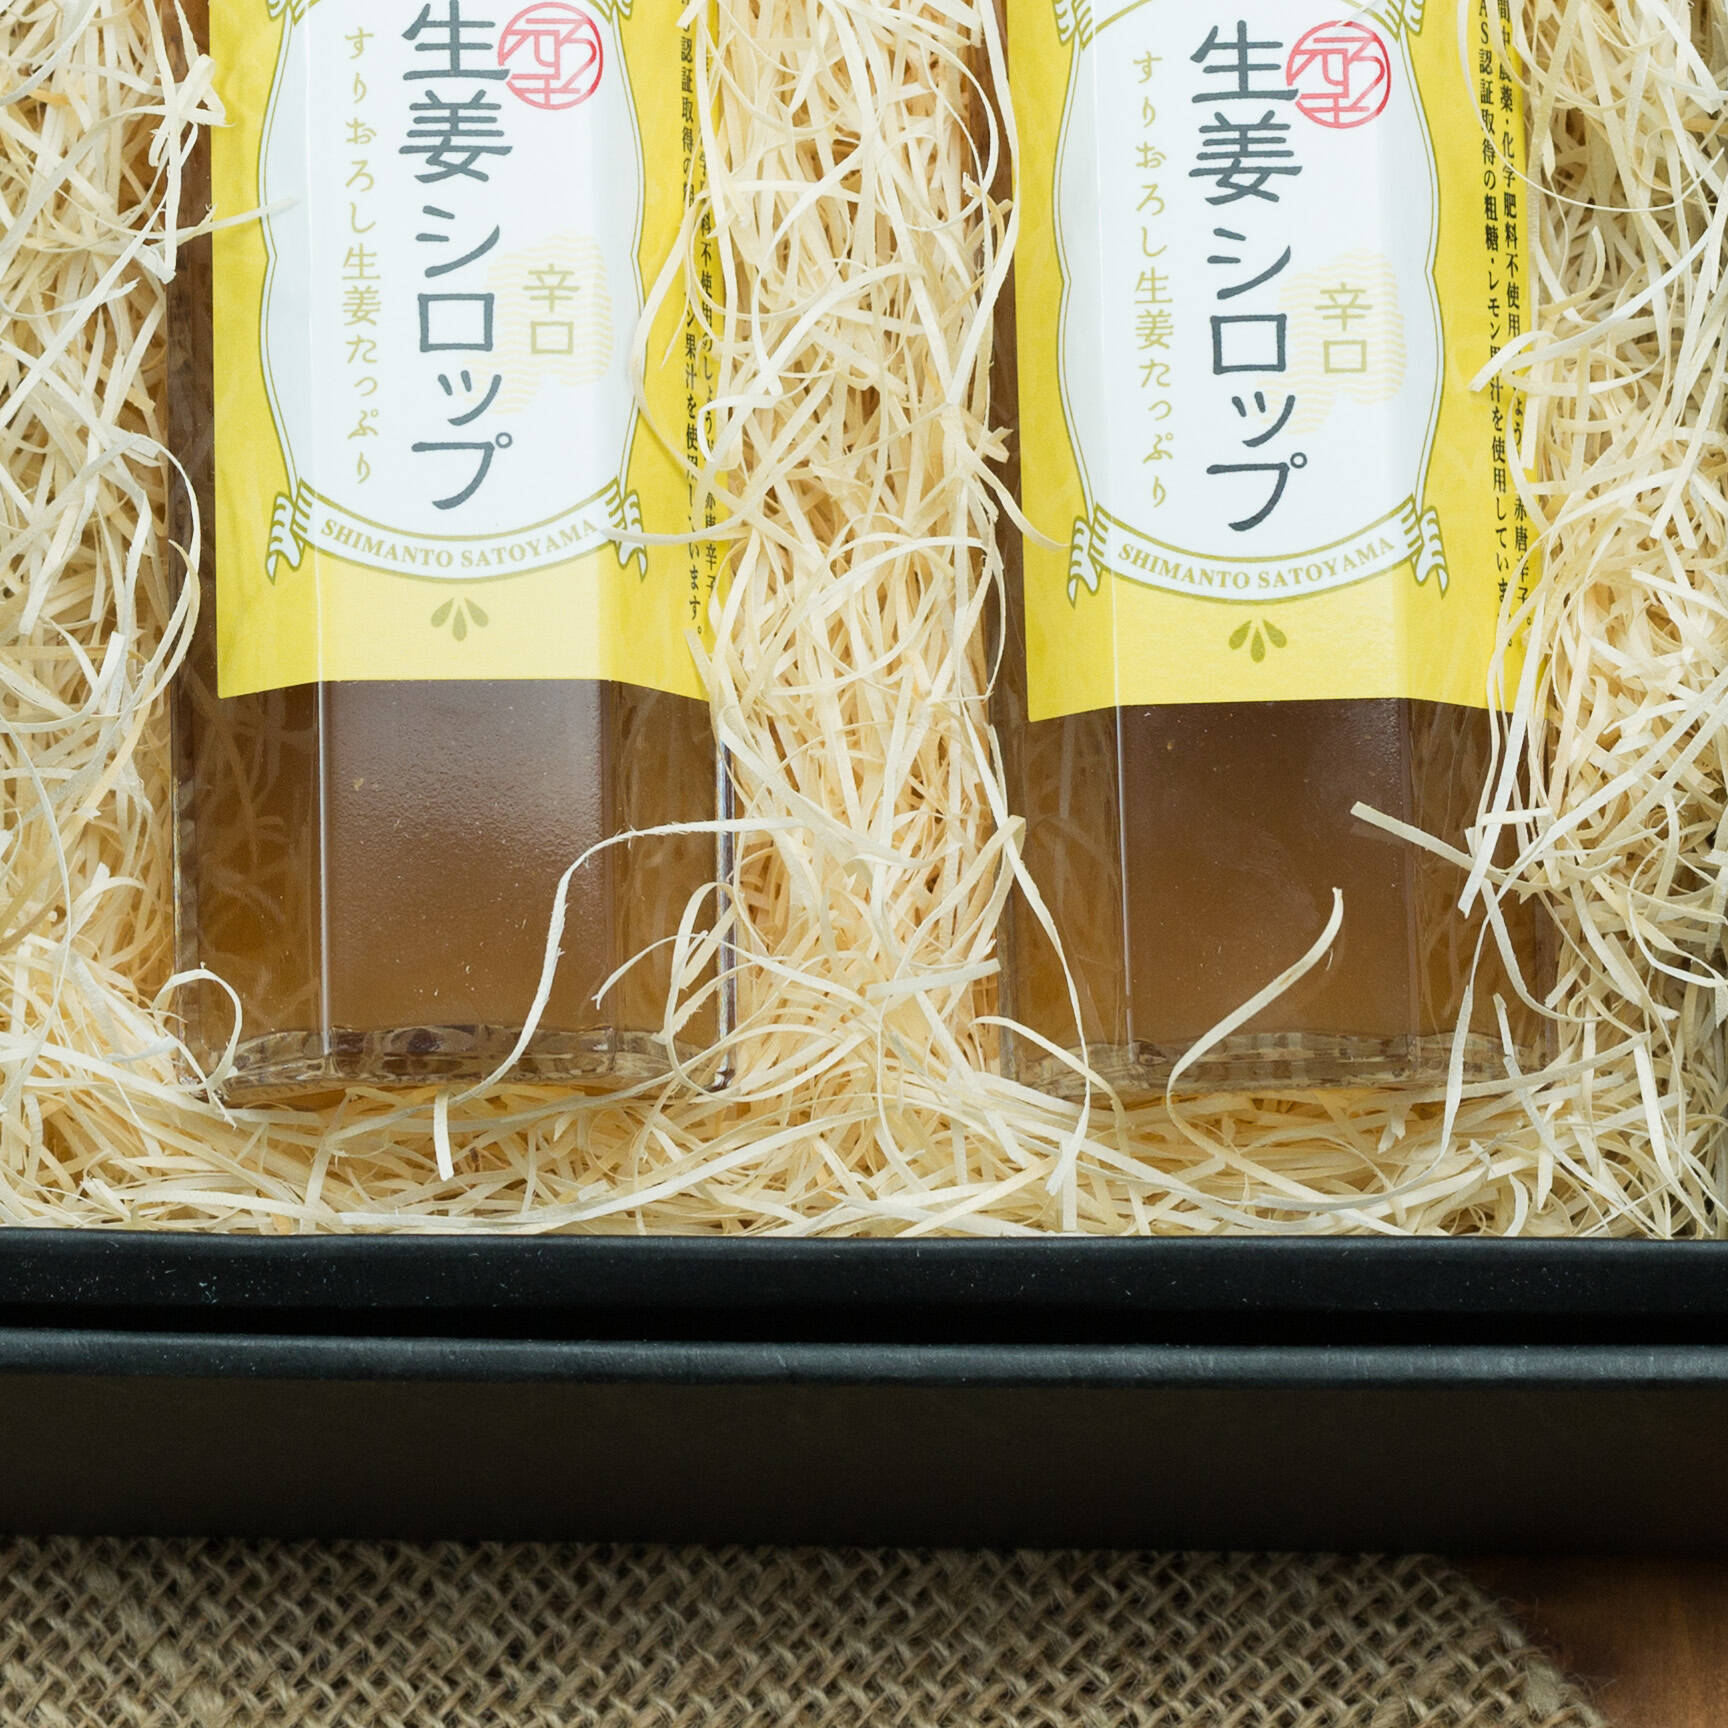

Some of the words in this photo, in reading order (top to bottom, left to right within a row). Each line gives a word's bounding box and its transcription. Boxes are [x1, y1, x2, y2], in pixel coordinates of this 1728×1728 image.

[342, 26, 382, 486] すりおろし生姜たっぷり
[1133, 49, 1175, 509] すりおろし生姜たっぷり
[1188, 20, 1308, 532] 生姜シロップ
[524, 264, 581, 357] 辛口
[1314, 282, 1373, 374] 辛口
[321, 519, 452, 568] SHIMANTO
[462, 519, 599, 567] SATOYAMA
[1119, 544, 1250, 590] SHIMANTO
[1258, 538, 1395, 589] SATOYAMA
